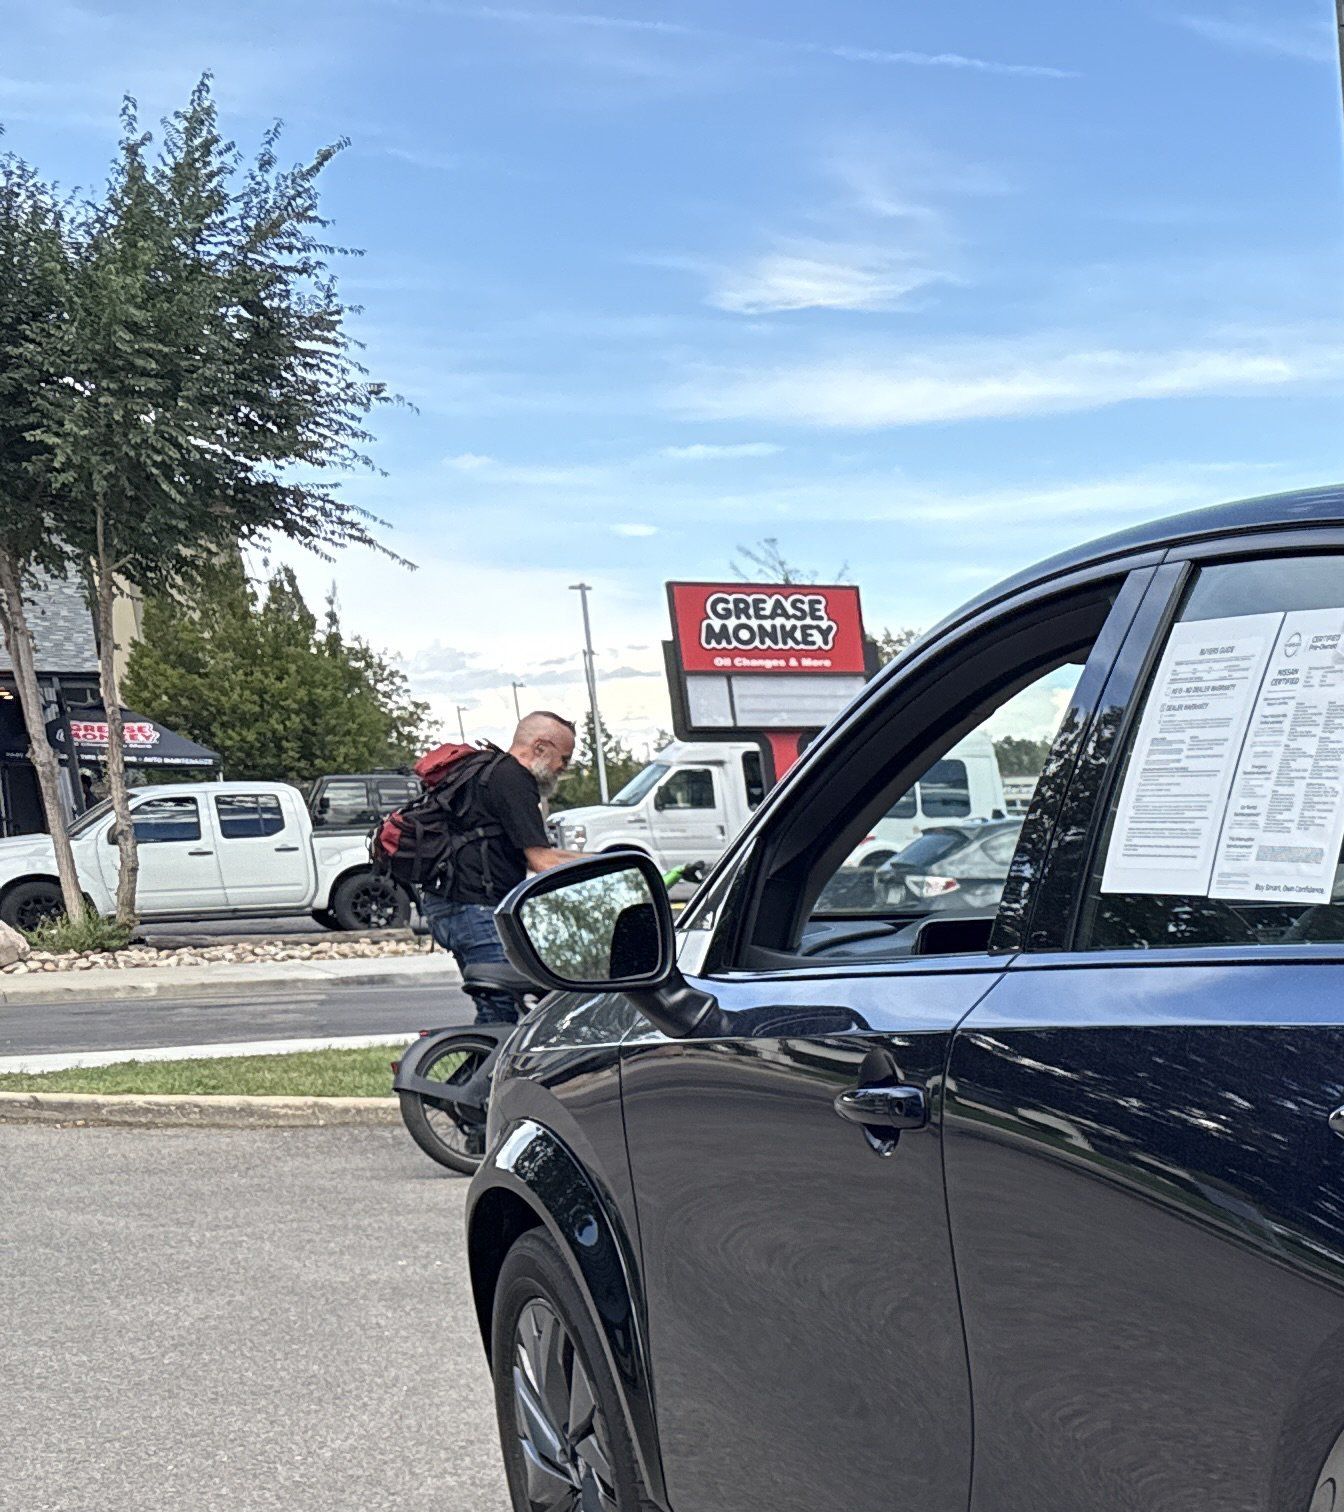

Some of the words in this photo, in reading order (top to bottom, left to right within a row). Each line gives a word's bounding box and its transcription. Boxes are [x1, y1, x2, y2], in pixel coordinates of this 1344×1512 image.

[710, 596, 825, 622] GREASE
[704, 622, 834, 646] MONKEY
[713, 656, 732, 667] Oil
[733, 656, 786, 669] Changes
[788, 656, 799, 667] &
[801, 657, 832, 667] More
[71, 724, 149, 734] GRESE
